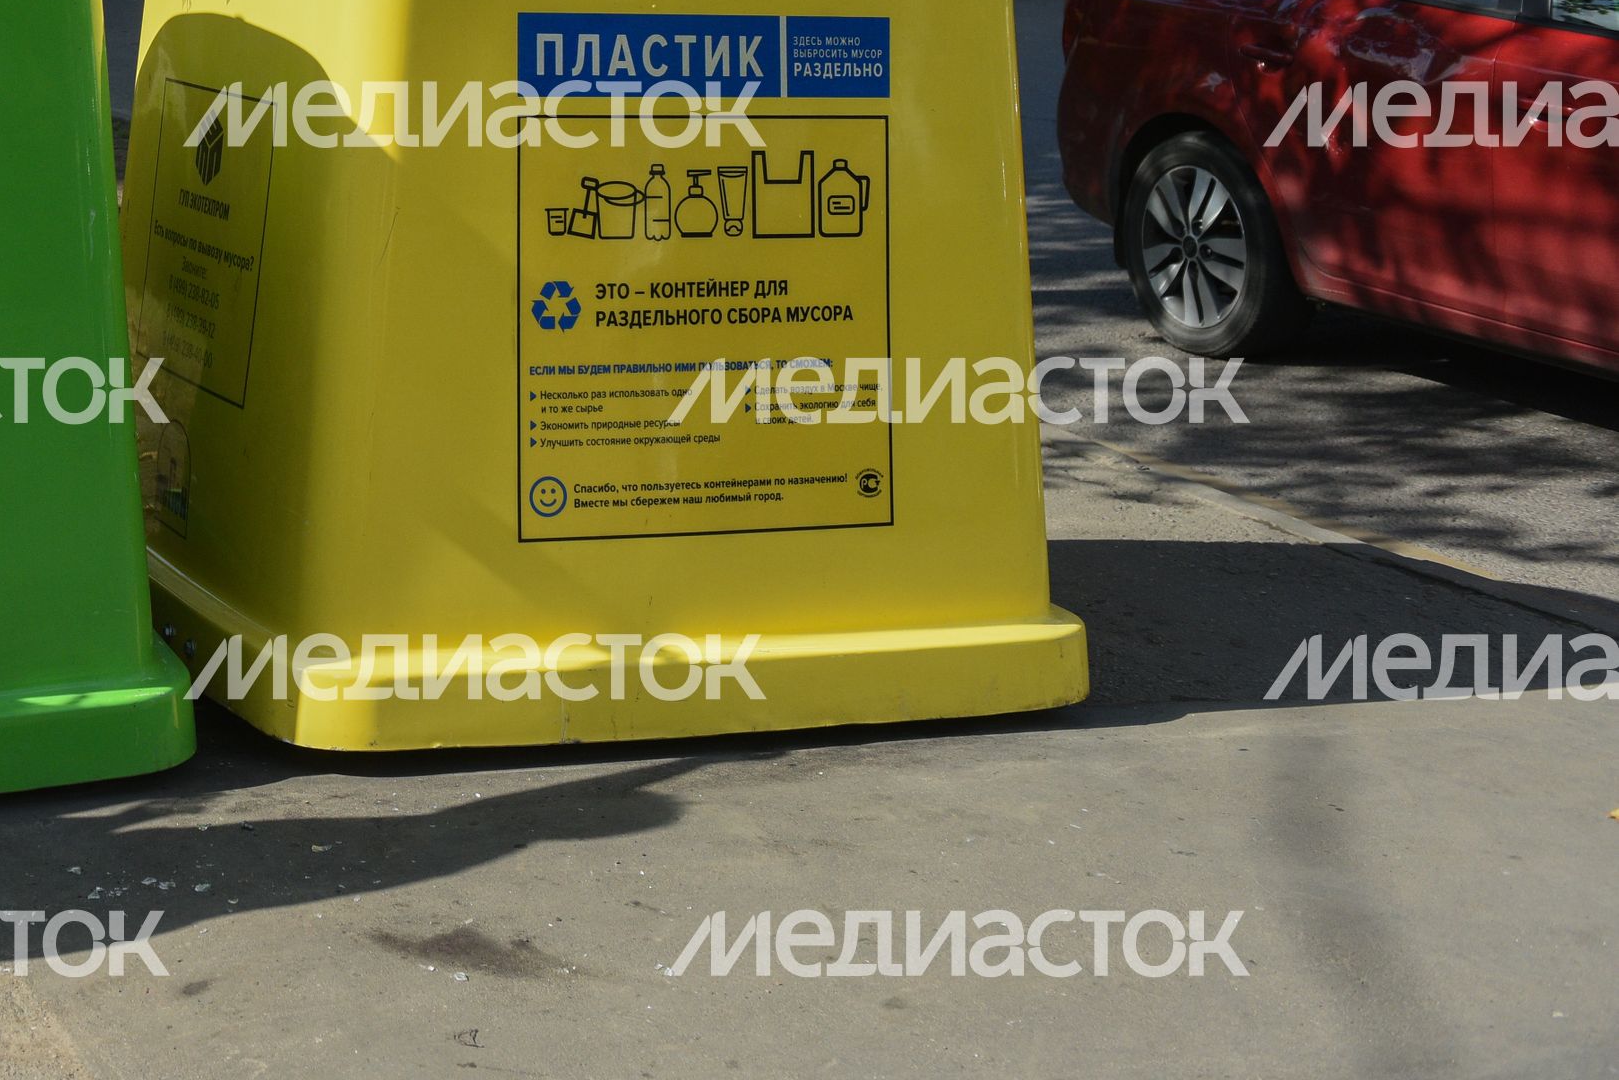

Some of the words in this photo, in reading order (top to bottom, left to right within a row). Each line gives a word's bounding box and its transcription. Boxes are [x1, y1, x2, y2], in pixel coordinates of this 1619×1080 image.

[793, 36, 822, 47] ЗДЕСЬ
[825, 36, 861, 46] МОЖНО
[536, 32, 765, 78] ПЛАСТИК
[793, 48, 848, 58] ВЫБРОСИТЬ
[851, 49, 883, 59] МУСОР
[793, 62, 883, 79] РАЗДЕЛЬНО
[189, 191, 231, 222] ЭКОТЕХПРОМ
[189, 236, 197, 251] по
[197, 241, 224, 264] вывозу
[595, 283, 630, 299] ЭТО
[650, 278, 750, 299] КОНТЕЙНЕР
[754, 280, 789, 299] ДЛЯ
[595, 308, 722, 329] РАЗДЕЛЬНОГО
[727, 307, 782, 324] СБОРА
[786, 305, 854, 322] МУСОРА
[529, 366, 555, 376] ЕСЛИ
[558, 365, 575, 375] МЫ
[578, 364, 611, 375] БУДЕМ
[613, 363, 671, 374] ПРАВИЛЬНО
[674, 362, 696, 373] ИМИ
[776, 359, 788, 369] ТО
[539, 391, 588, 401] Несколько
[591, 391, 607, 401] раз
[609, 389, 669, 399] использовать
[671, 388, 693, 397] одно
[827, 383, 857, 393] Москве
[548, 405, 559, 414] то
[561, 405, 574, 414] же
[576, 404, 604, 415] сырье
[799, 400, 838, 411] экологию
[857, 398, 876, 408] себя
[539, 421, 589, 431] Экономить
[591, 419, 641, 431] природные
[643, 419, 681, 430] ресурсы
[540, 438, 584, 449] Улучшить
[586, 437, 632, 447] состояние
[634, 433, 691, 447] окружающей
[693, 433, 721, 445] среды
[573, 483, 619, 495] Спасибо,
[621, 483, 639, 493] что
[640, 481, 702, 493] пользуетесь
[703, 476, 772, 490] контейнерами
[774, 477, 786, 486] по
[787, 473, 848, 486] назначению!
[573, 498, 610, 509] Вместе
[612, 498, 628, 508] мы
[630, 495, 680, 509] сбережем
[682, 495, 703, 505] наш
[705, 492, 751, 505] любимый
[754, 491, 784, 504] город.
